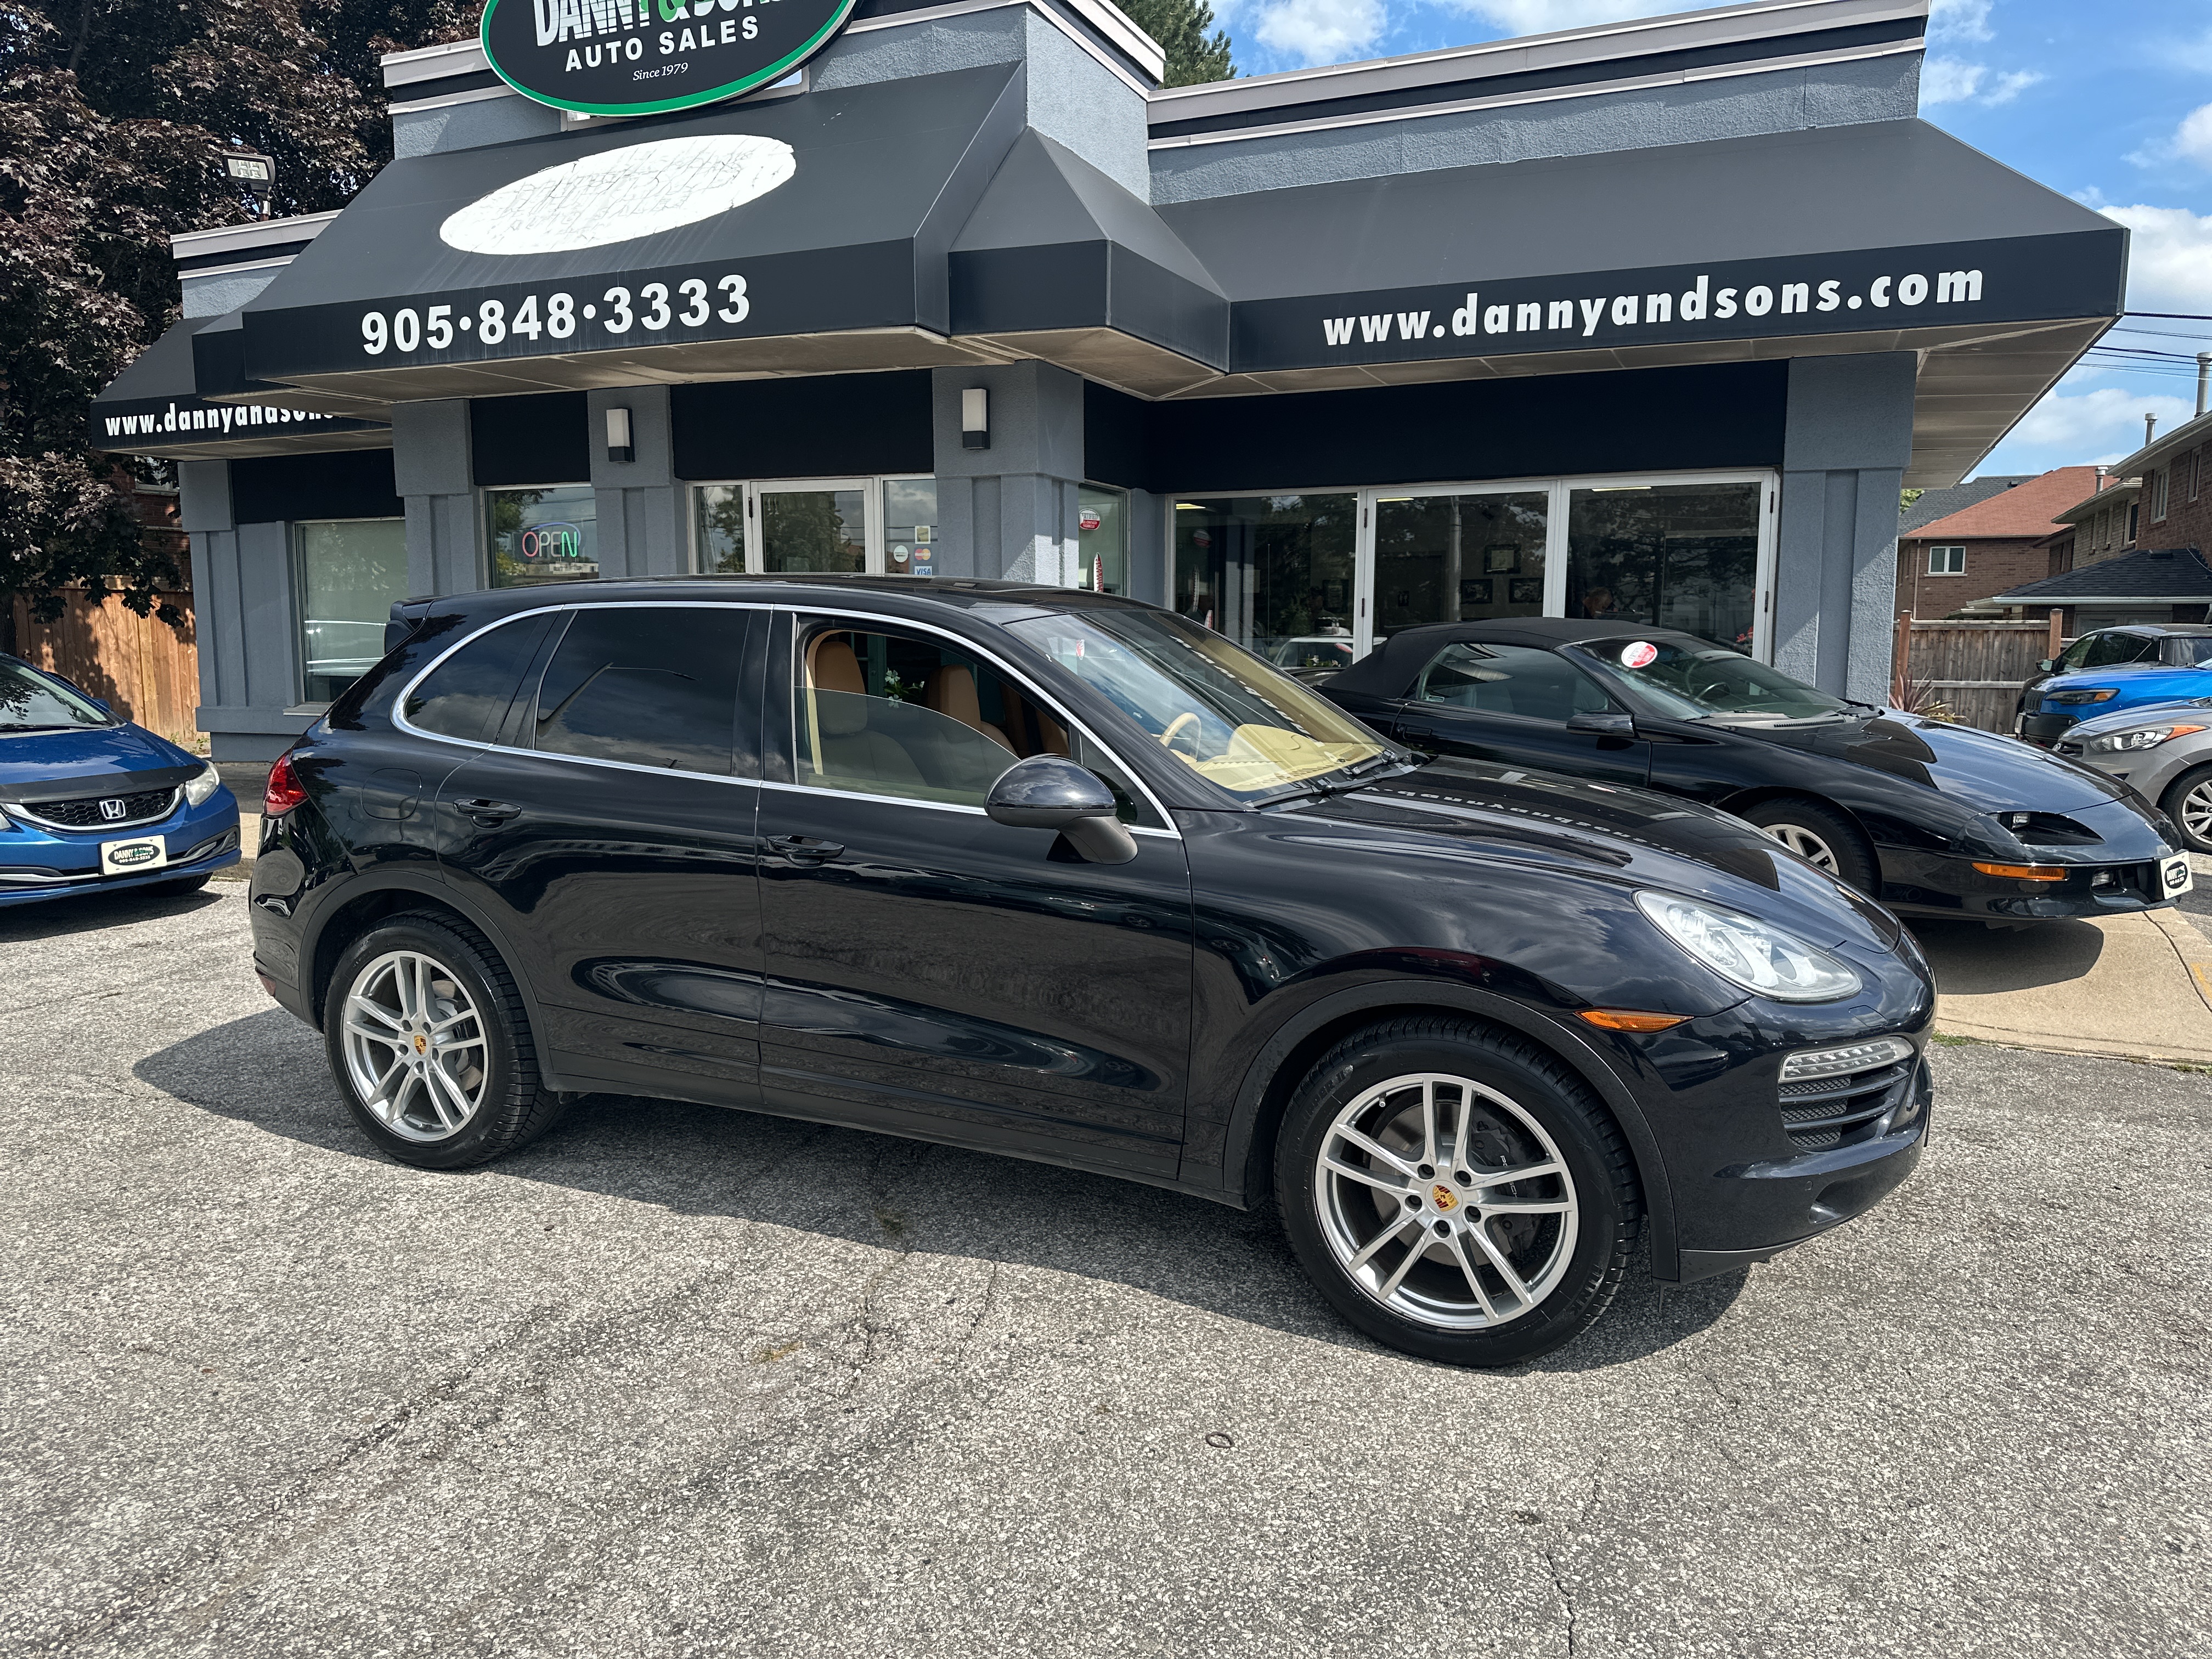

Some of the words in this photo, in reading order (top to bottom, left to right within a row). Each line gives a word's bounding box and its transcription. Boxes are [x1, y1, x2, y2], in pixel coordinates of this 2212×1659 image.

[565, 38, 642, 72] AUTO
[659, 15, 758, 54] SALES
[633, 65, 659, 81] Since
[661, 62, 689, 76] 1979
[1323, 268, 1983, 346] www.dannyandsons.com
[522, 531, 577, 557] OPEN
[114, 849, 133, 860] DANNY
